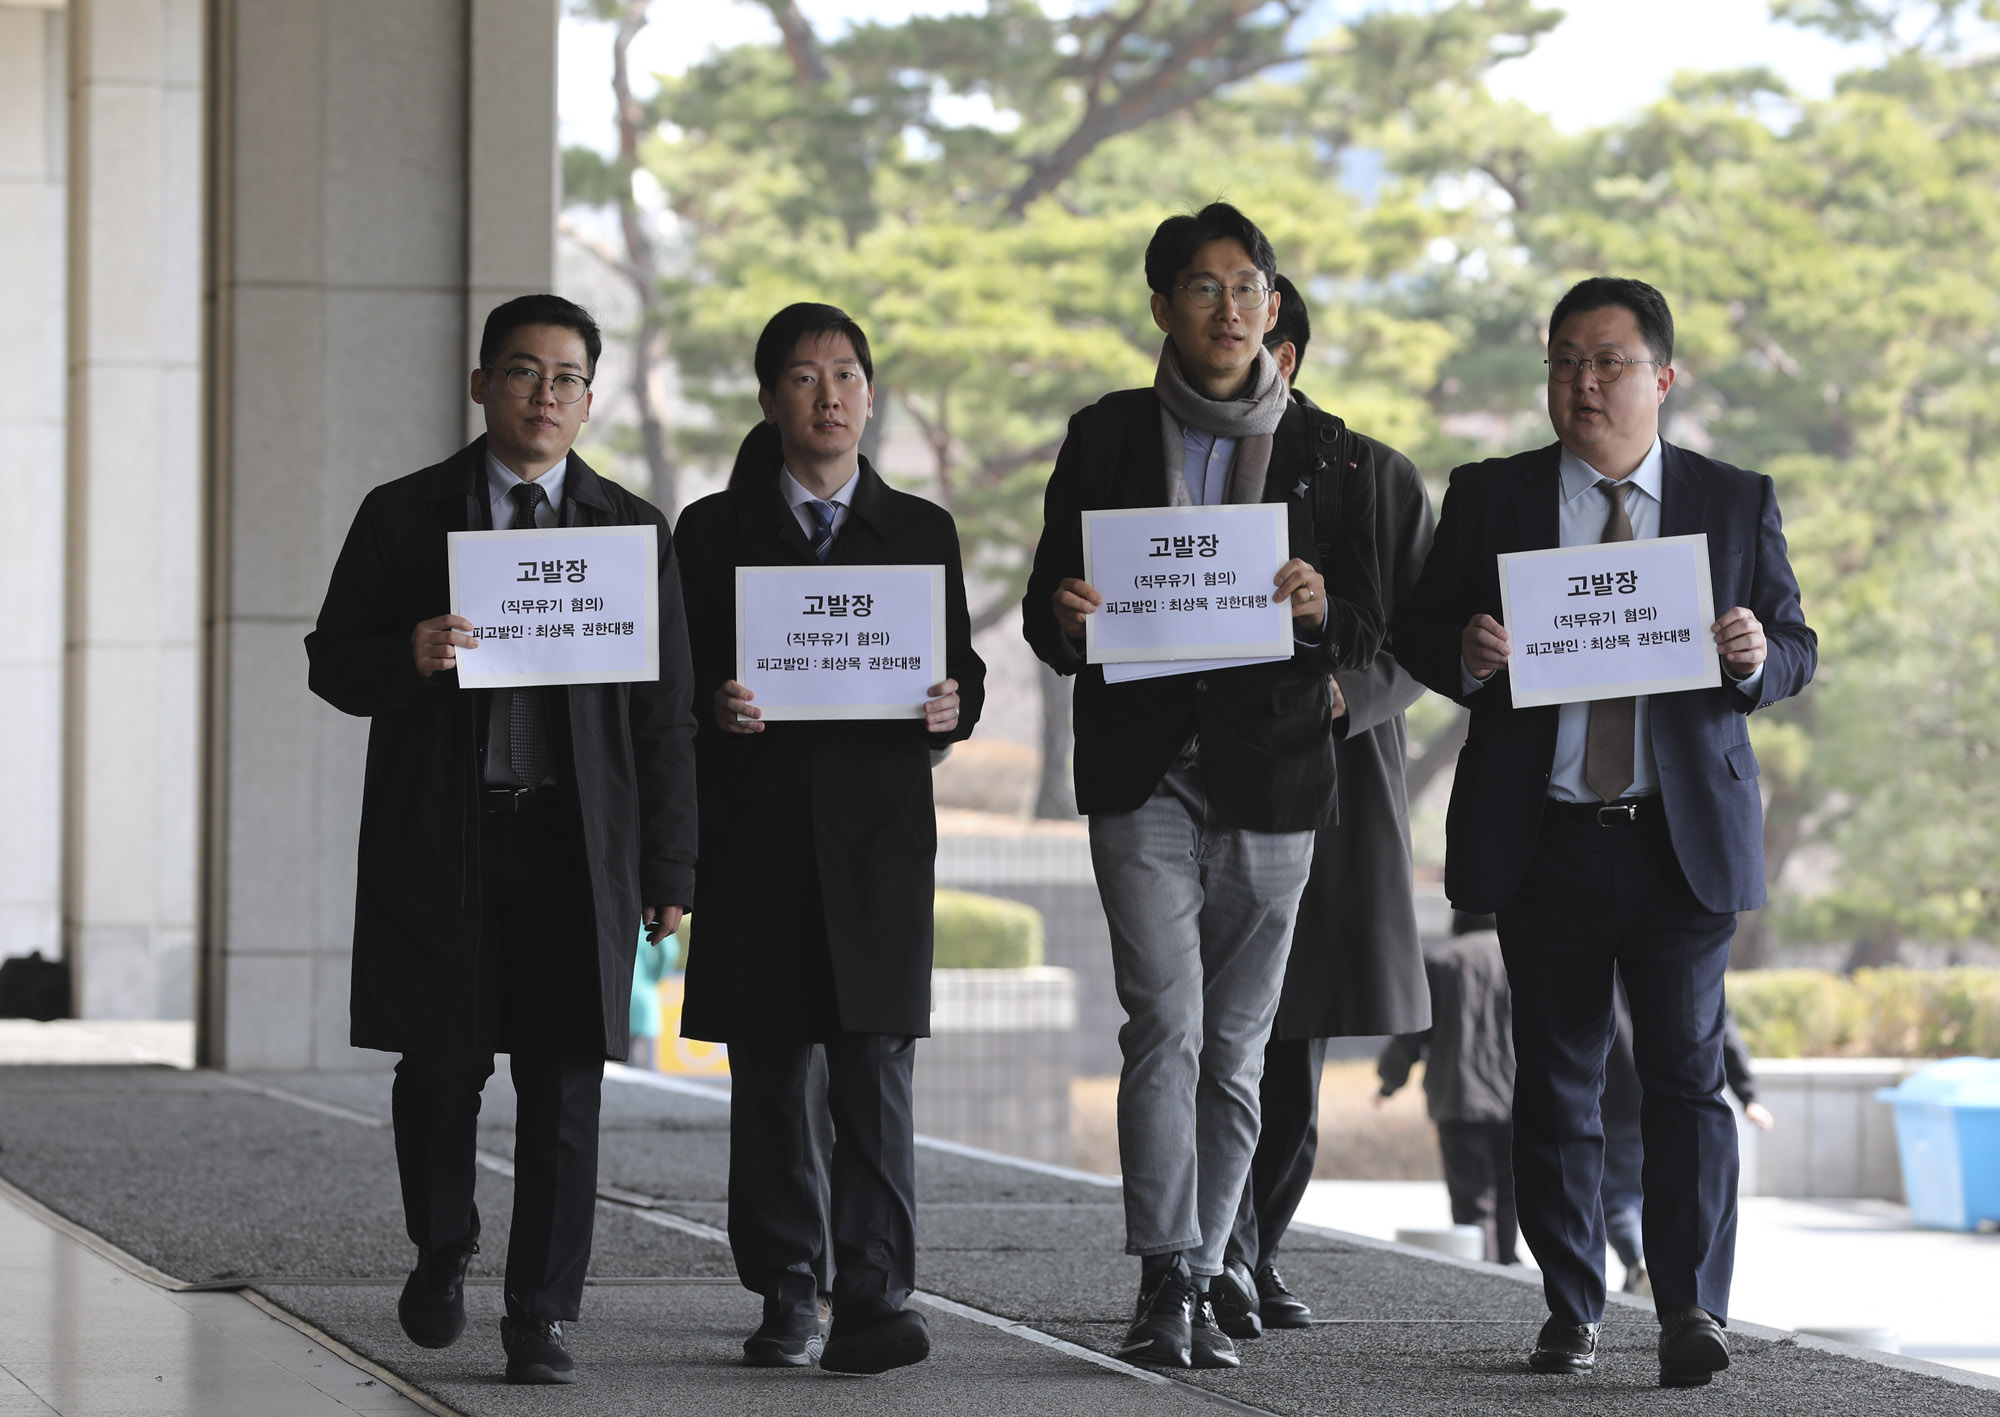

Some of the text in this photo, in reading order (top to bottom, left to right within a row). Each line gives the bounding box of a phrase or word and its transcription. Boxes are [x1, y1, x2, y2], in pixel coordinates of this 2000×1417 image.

[1149, 534, 1219, 558] 고발장
[517, 559, 587, 583] 고발장
[1135, 571, 1236, 589] (직무유기 혐의)
[1568, 570, 1638, 596] 고발장
[502, 597, 603, 614] (직무유기 혐의)
[803, 594, 873, 617] 고발장
[1169, 598, 1208, 611] 최상목
[1216, 595, 1267, 609] 권한대행
[1554, 607, 1657, 629] (직무유기 혐의)
[536, 624, 575, 637] 최상목
[582, 622, 633, 636] 권한대행
[787, 632, 889, 646] (직무유기 혐의)
[1591, 635, 1630, 650] 최상목
[1638, 629, 1690, 646] 권한대행
[822, 657, 861, 670] 최상목
[868, 657, 920, 670] 권한대행
